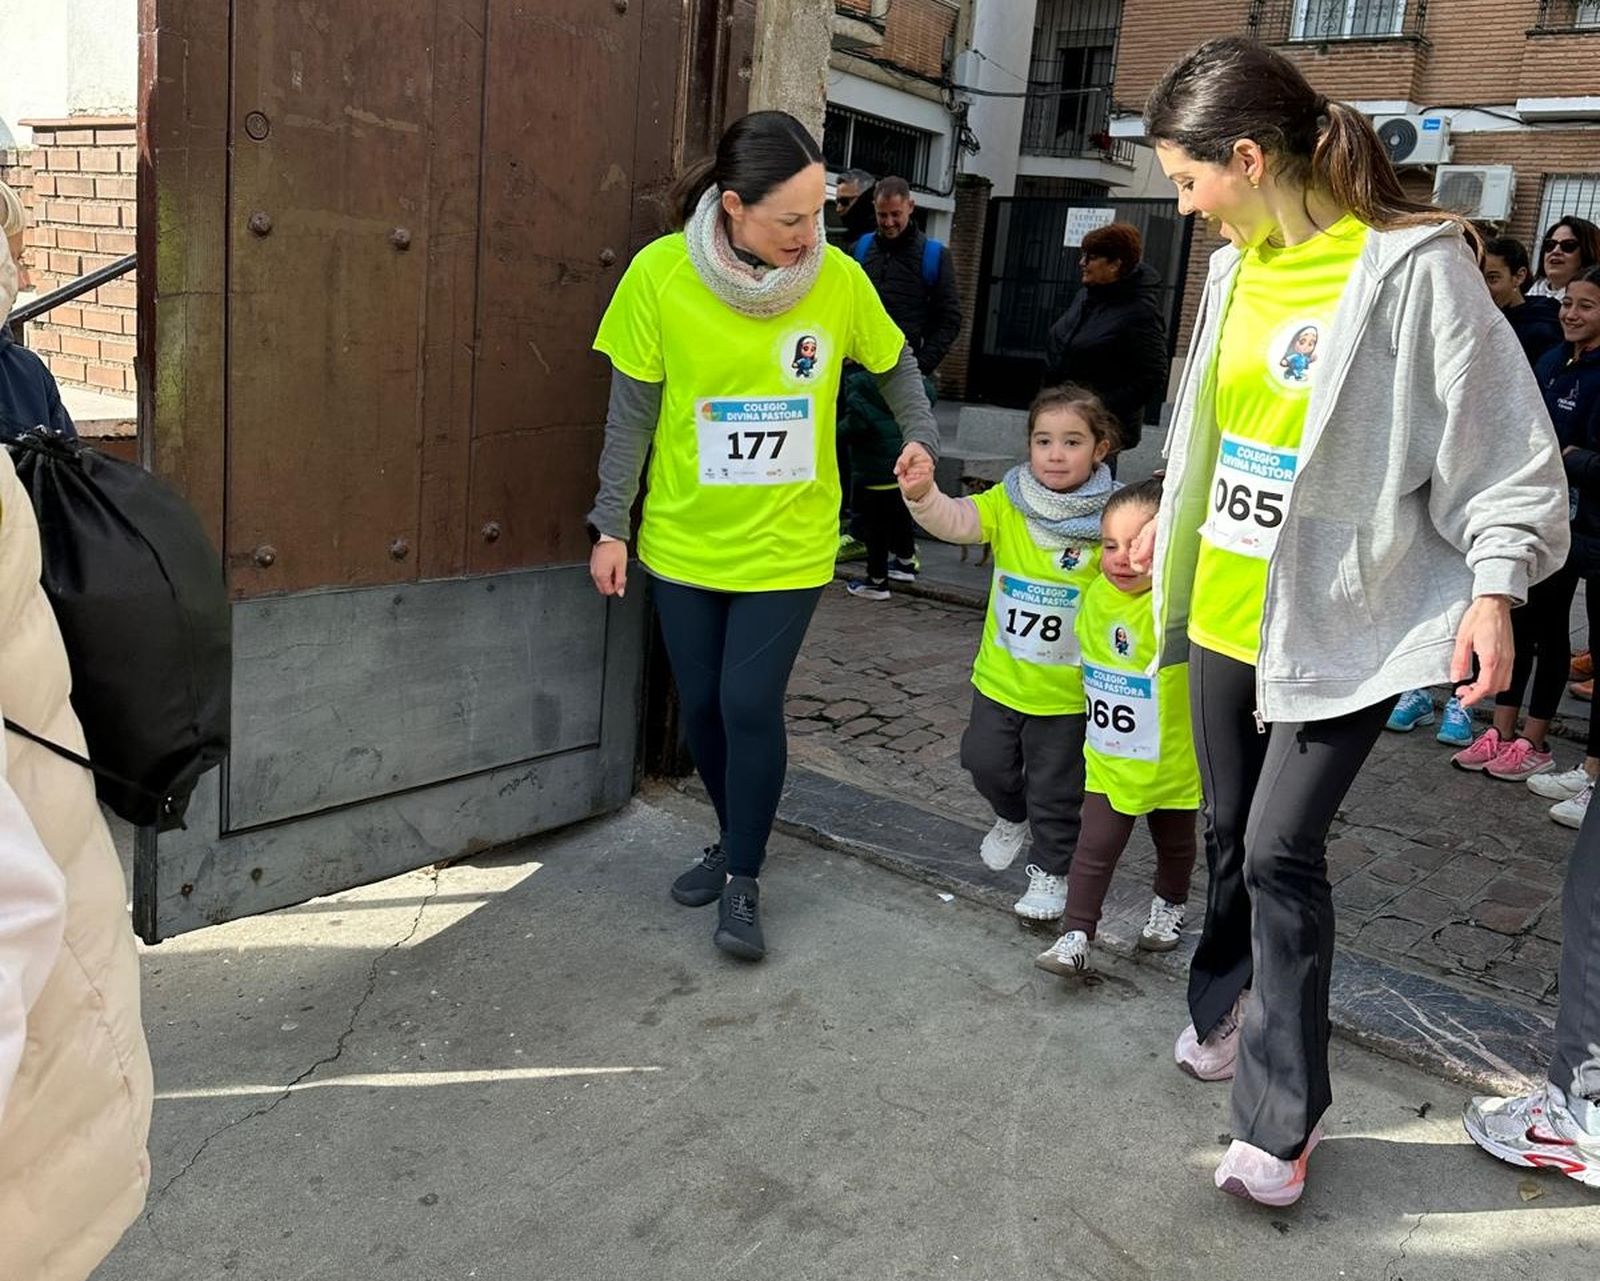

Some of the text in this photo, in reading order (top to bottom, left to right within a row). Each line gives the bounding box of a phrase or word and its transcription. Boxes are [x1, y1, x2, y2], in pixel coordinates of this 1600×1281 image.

[743, 402, 787, 412] COLEGIO
[727, 410, 803, 421] DIVINA PASTORA
[728, 430, 788, 460] 177
[1237, 446, 1280, 466] COLEGIO
[1250, 463, 1294, 480] PASTOR
[1215, 478, 1283, 528] 065
[1012, 589, 1040, 604] DIVINA
[1027, 585, 1067, 597] COLEGIO
[1006, 608, 1062, 641] 178
[1093, 670, 1127, 685] COLEGIO
[1104, 682, 1144, 697] PASTORA
